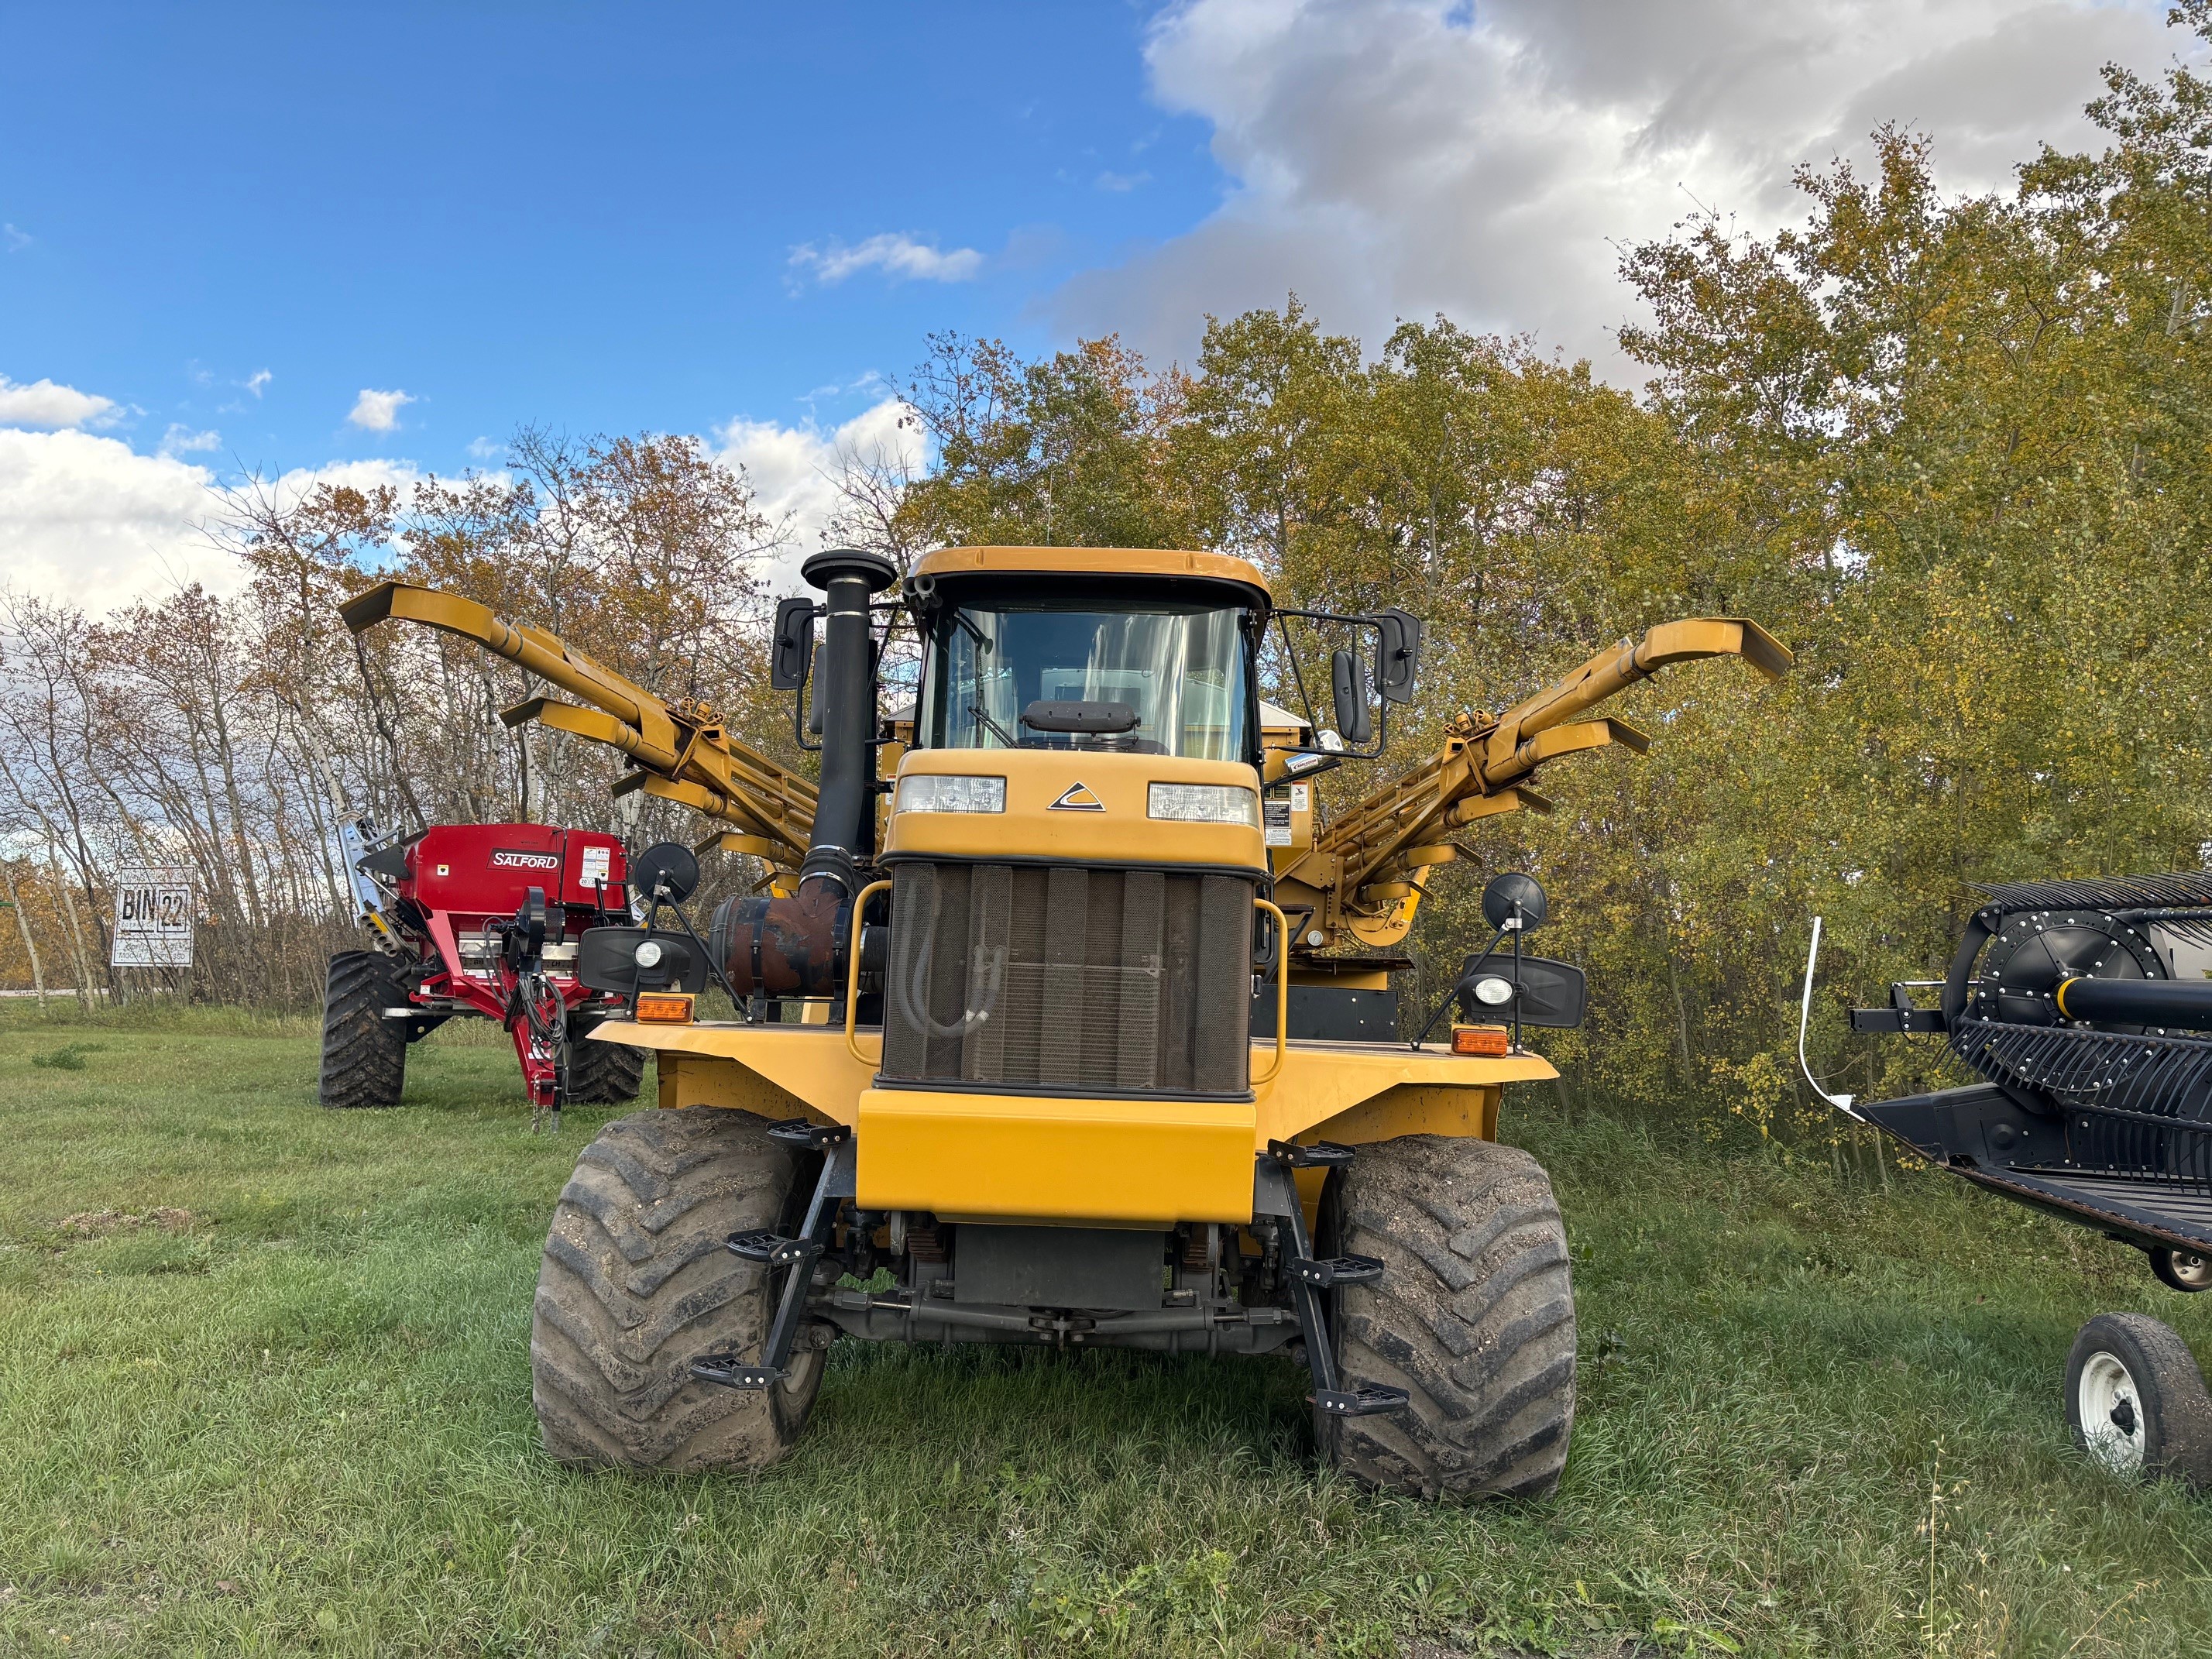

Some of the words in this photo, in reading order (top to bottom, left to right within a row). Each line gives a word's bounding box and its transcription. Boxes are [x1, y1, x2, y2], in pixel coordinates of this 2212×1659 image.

[493, 853, 558, 869] SALFORD
[122, 889, 155, 919] BIN
[162, 896, 183, 926] 22
